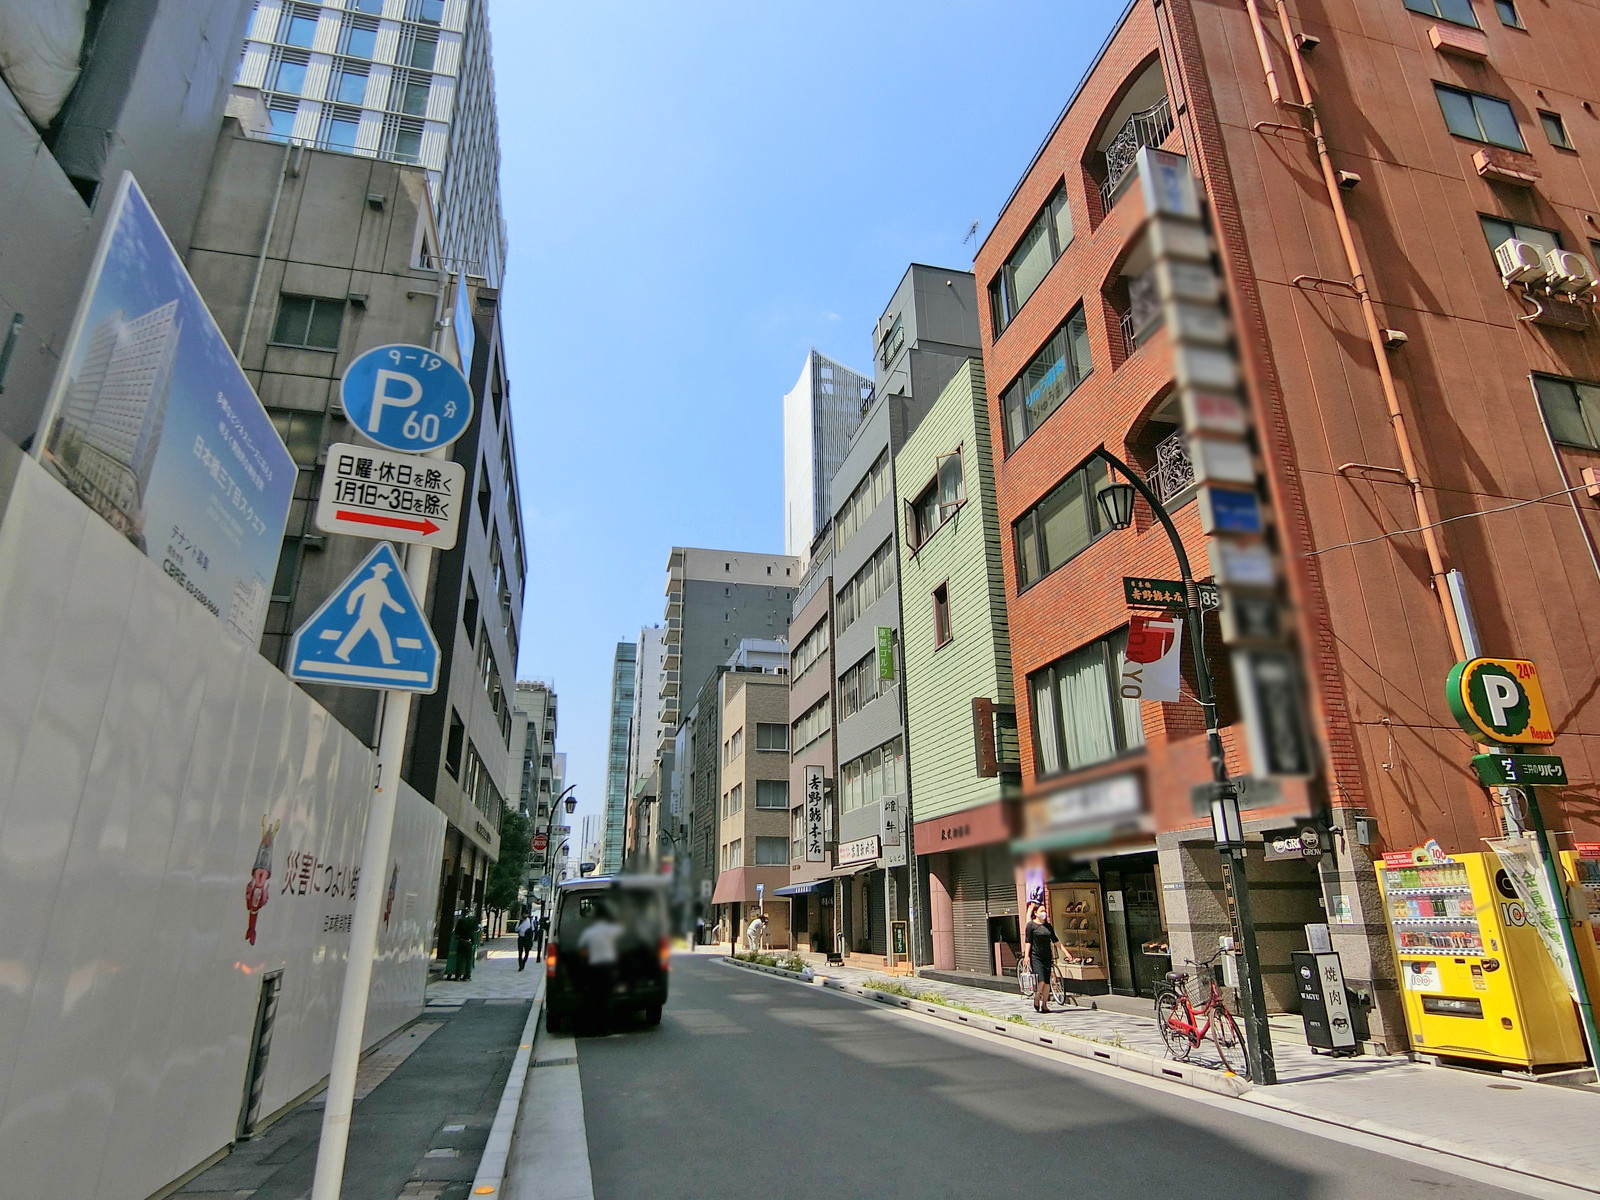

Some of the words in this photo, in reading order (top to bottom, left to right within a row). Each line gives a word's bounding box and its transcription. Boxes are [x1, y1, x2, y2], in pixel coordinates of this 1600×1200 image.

[388, 350, 442, 372] 9-19
[367, 368, 423, 434] P
[337, 454, 453, 493] 日曜・休日を除く
[162, 558, 187, 589] CBRE
[1516, 663, 1535, 679] 24h
[1481, 674, 1520, 727] P
[1529, 726, 1554, 741] Repark
[1302, 848, 1321, 856] GROW
[1300, 992, 1320, 1001] WAGYU
[1323, 966, 1342, 1006] 焼肉
